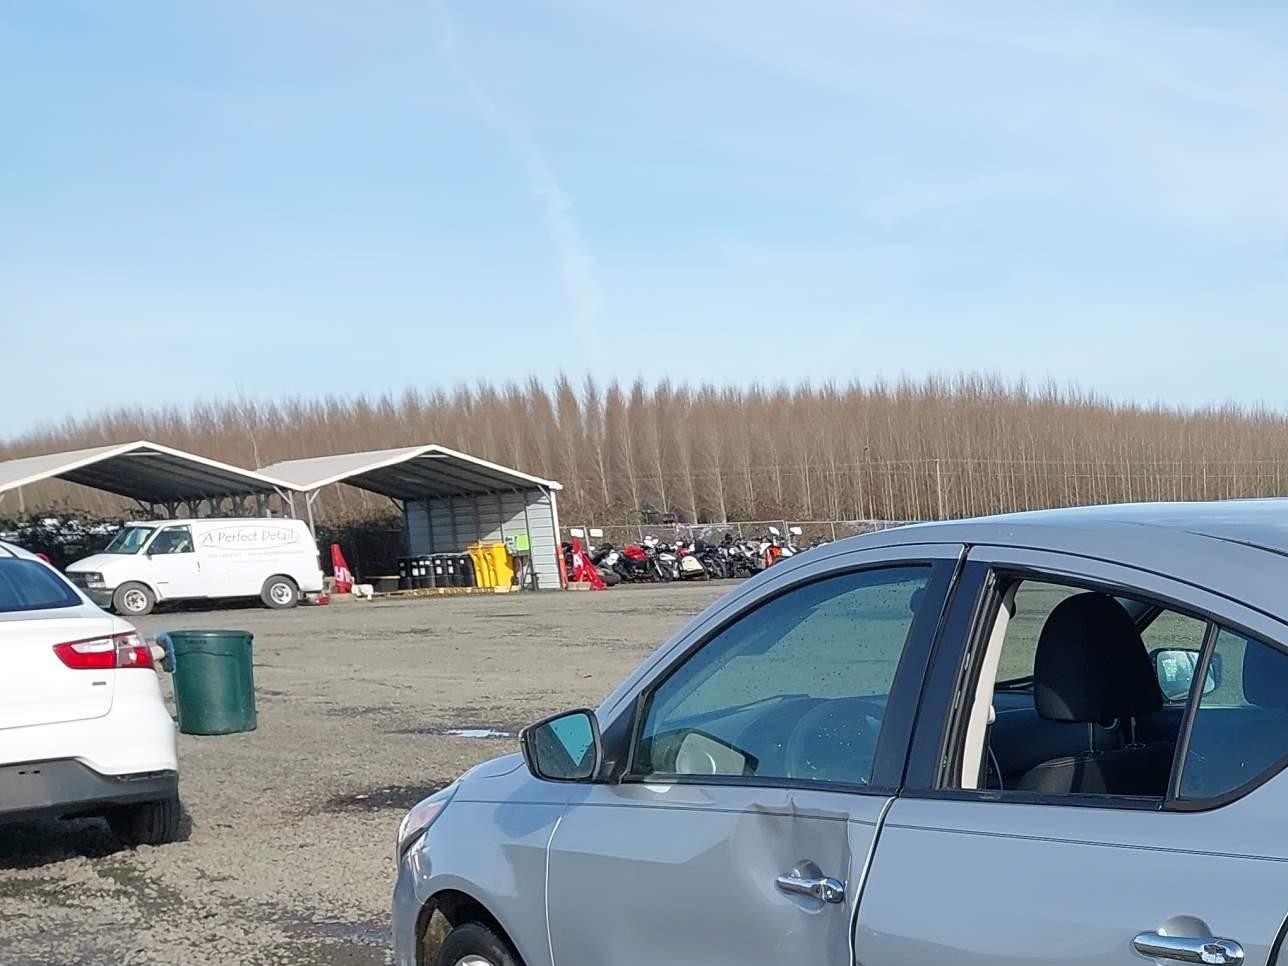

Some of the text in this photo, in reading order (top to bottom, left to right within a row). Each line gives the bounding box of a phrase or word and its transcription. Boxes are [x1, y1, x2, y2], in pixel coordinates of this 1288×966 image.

[202, 528, 295, 544] A Perfect Detail
